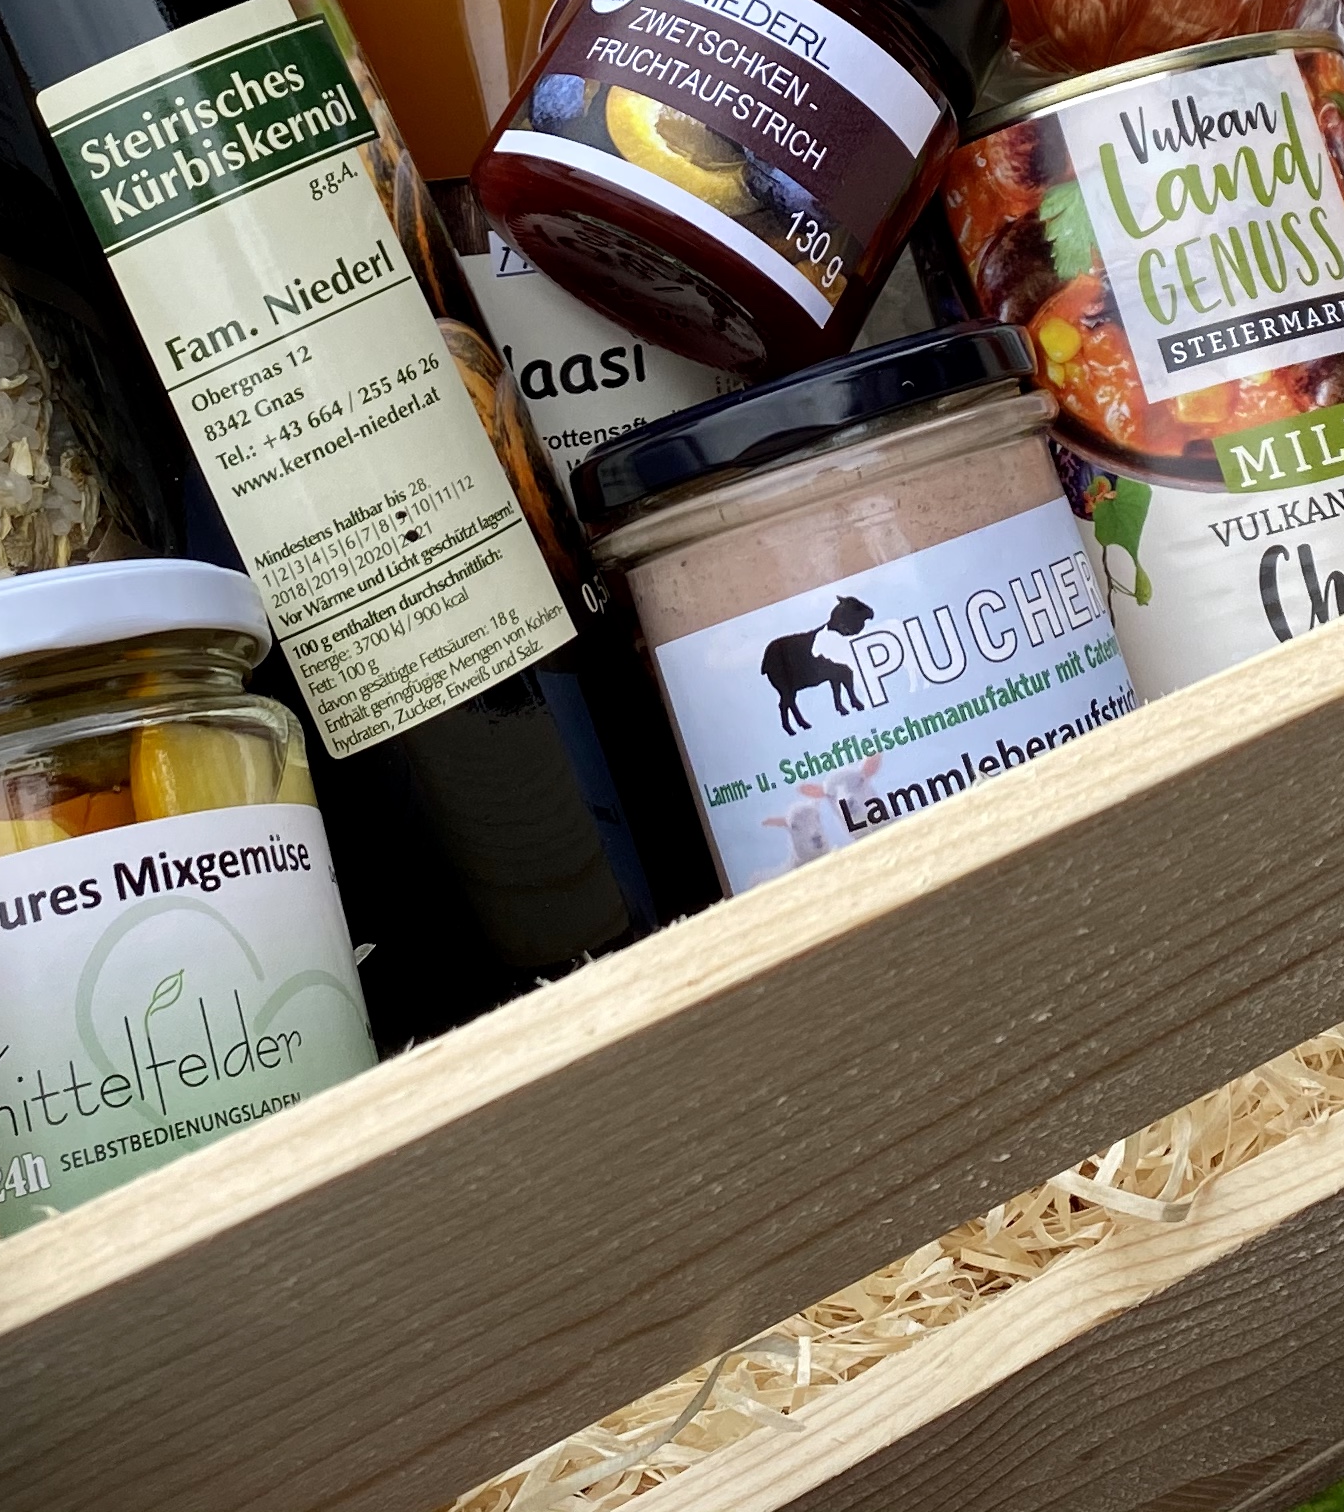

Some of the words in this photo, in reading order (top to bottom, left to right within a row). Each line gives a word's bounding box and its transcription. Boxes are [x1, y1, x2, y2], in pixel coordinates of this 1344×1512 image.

[585, 35, 829, 172] FRUCHTAUFSTRICH
[628, 5, 813, 108] ZWETSCHKEN
[79, 62, 306, 180] Steirisches
[99, 82, 358, 226] Kürbiskernöl
[1098, 90, 1324, 240] Land
[1118, 94, 1278, 165] Vulkan
[308, 161, 359, 201] g.g.A.
[785, 209, 831, 266] 130
[821, 258, 846, 288] g
[164, 317, 259, 373] Fam.
[262, 239, 396, 326] Niederl
[190, 361, 284, 414] Obergnas
[285, 345, 314, 368] 12
[203, 409, 252, 444] 8342
[254, 386, 306, 419] Gnas
[215, 443, 258, 472] Tel.:
[262, 419, 303, 450] +43
[307, 399, 344, 429] 664
[357, 376, 392, 406] 255
[396, 365, 418, 386] 46
[418, 352, 440, 376] 26
[542, 416, 648, 451] ottensaft
[230, 386, 442, 498] www.kernoel-niederl.at
[253, 525, 334, 571] Mindestens
[332, 500, 384, 535] haltbar
[384, 489, 408, 509] bis
[278, 608, 304, 628] Vor
[303, 587, 357, 619] Wärme
[356, 570, 386, 593] und
[384, 553, 420, 580] Licht
[419, 520, 482, 566] geschützt
[479, 500, 516, 531] lagern!
[291, 637, 321, 660] 100
[320, 634, 334, 652] g
[332, 604, 398, 647] enthalten
[398, 546, 504, 612] durchschnittlich:
[299, 647, 354, 679] Energie:
[354, 627, 391, 656] 3700
[390, 618, 408, 639] kJ
[413, 601, 444, 627] 900
[443, 585, 471, 612] kcal
[849, 549, 1108, 709] PUCHER
[307, 676, 337, 698] Fett:
[338, 662, 368, 684] 100
[367, 658, 381, 675] g
[317, 689, 358, 716] davon
[354, 661, 420, 702] gesättigte
[418, 624, 491, 667] Fettsäuren:
[489, 611, 509, 630] 18
[506, 607, 520, 626] g
[324, 703, 370, 735] Enthält
[370, 671, 449, 719] geringfügige
[448, 639, 504, 676] Mengen
[502, 625, 528, 647] von
[525, 604, 565, 634] Kohlen-
[332, 722, 397, 754] hydraten,
[395, 693, 448, 725] Zucker,
[445, 667, 492, 701] Eiweiß
[491, 651, 519, 675] und
[518, 637, 546, 661] Salz.
[703, 779, 754, 809] Lamm-
[755, 768, 777, 794] u.
[778, 668, 1053, 787] Schaffleischmanufaktur
[1054, 650, 1086, 684] mit
[113, 834, 312, 902] Mixgemüse
[59, 1090, 302, 1173] SELBSTBEDIENUNGSLADEN
